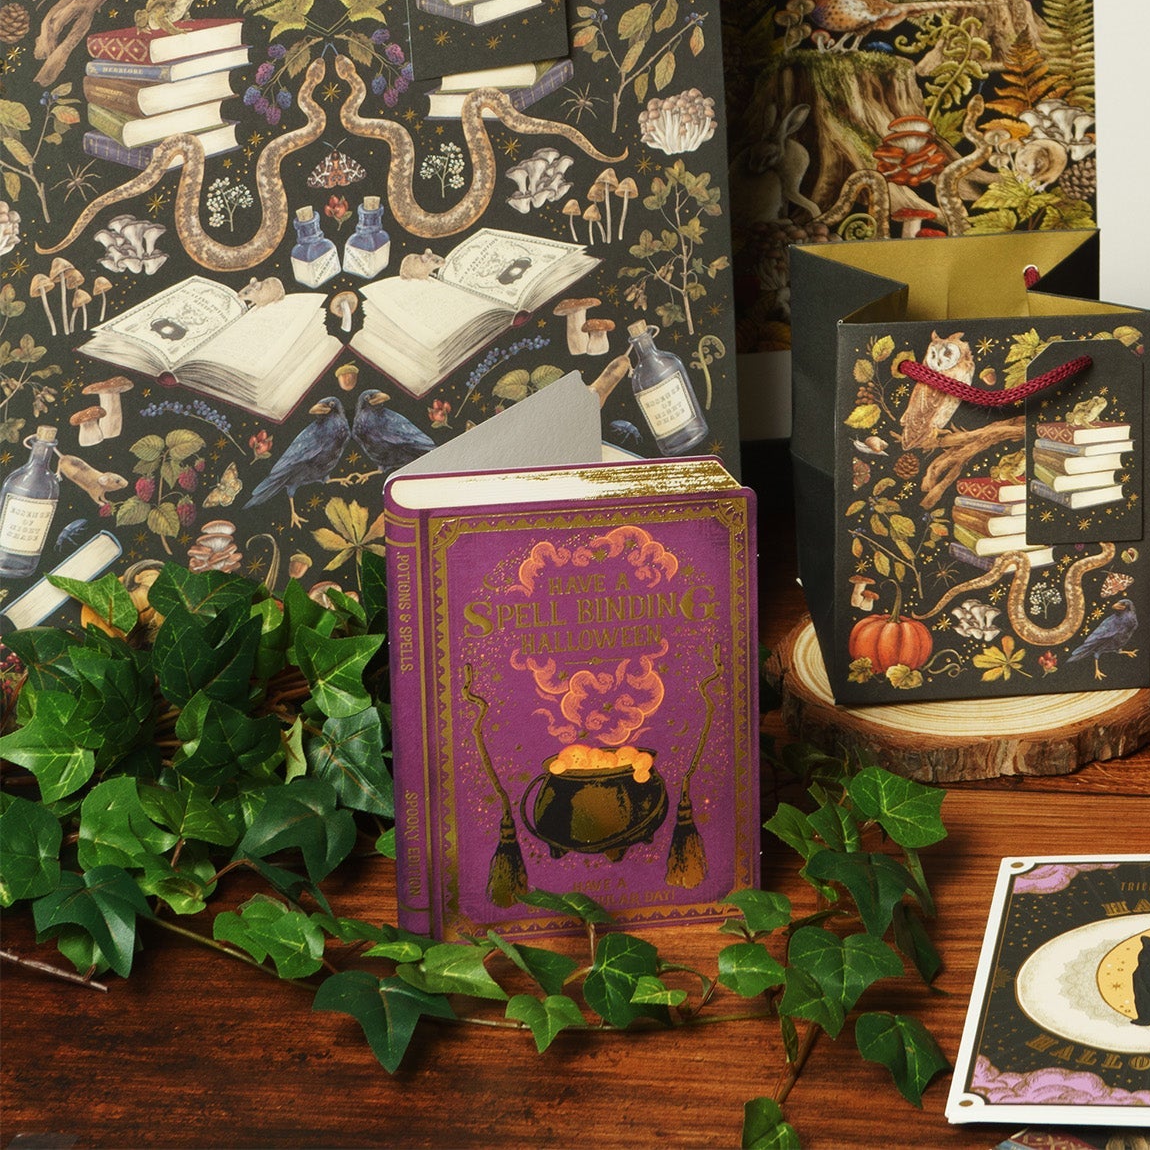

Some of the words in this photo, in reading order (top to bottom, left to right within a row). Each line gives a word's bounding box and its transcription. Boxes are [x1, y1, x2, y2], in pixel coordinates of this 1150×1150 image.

[549, 574, 606, 596] HAVE
[615, 572, 630, 591] A
[463, 600, 568, 638] SPELL
[576, 584, 721, 625] BINDING
[521, 623, 662, 655] HALLOWEEN
